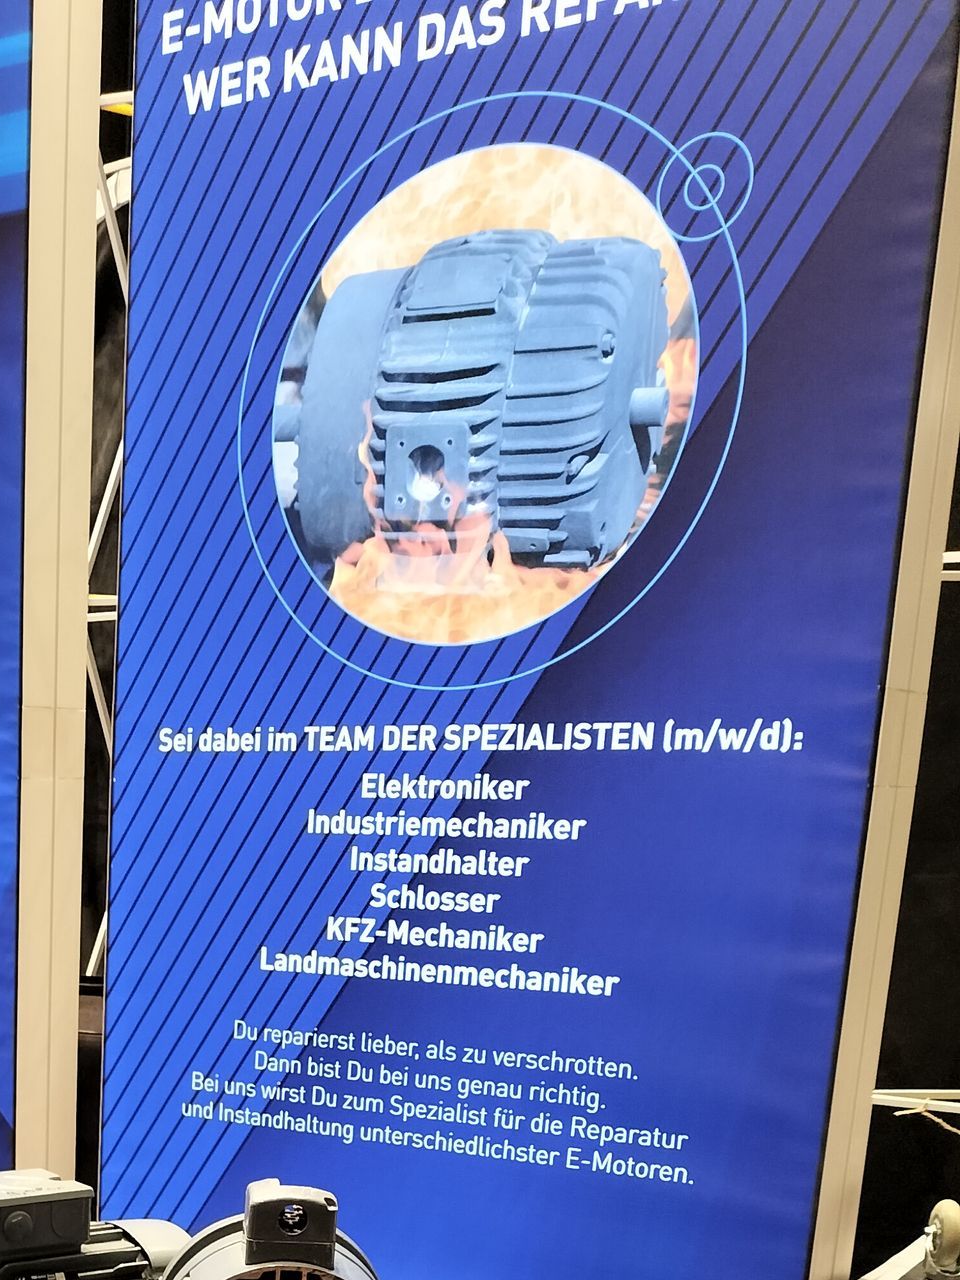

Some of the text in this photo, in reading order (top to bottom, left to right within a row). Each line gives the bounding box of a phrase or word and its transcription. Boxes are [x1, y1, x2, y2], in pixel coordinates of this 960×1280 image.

[183, 55, 271, 116] WER
[283, 21, 403, 94] KANN
[417, 0, 506, 62] DAS
[157, 718, 804, 754] Sei dabei im TEAM DER SPEZIALISTEN (m/w/d):
[360, 772, 530, 801] Elektroniker
[306, 809, 587, 841] Industriemechaniker
[350, 846, 530, 878] Instandhalter
[369, 883, 501, 914] Schlosser
[326, 916, 544, 954] KFZ-Mechaniker
[259, 947, 620, 997] Landmaschinenmechaniker
[233, 1020, 639, 1081] Du reparierst lieber, als zu verschrotten.
[254, 1051, 607, 1114] Dann bist Du bei uns genau richtig.
[191, 1071, 688, 1150] Bei uns wirst Du zum Spezialist für die Reparatur
[181, 1099, 694, 1185] und Instandhaltung unterschiedlichster E-Motoren.
